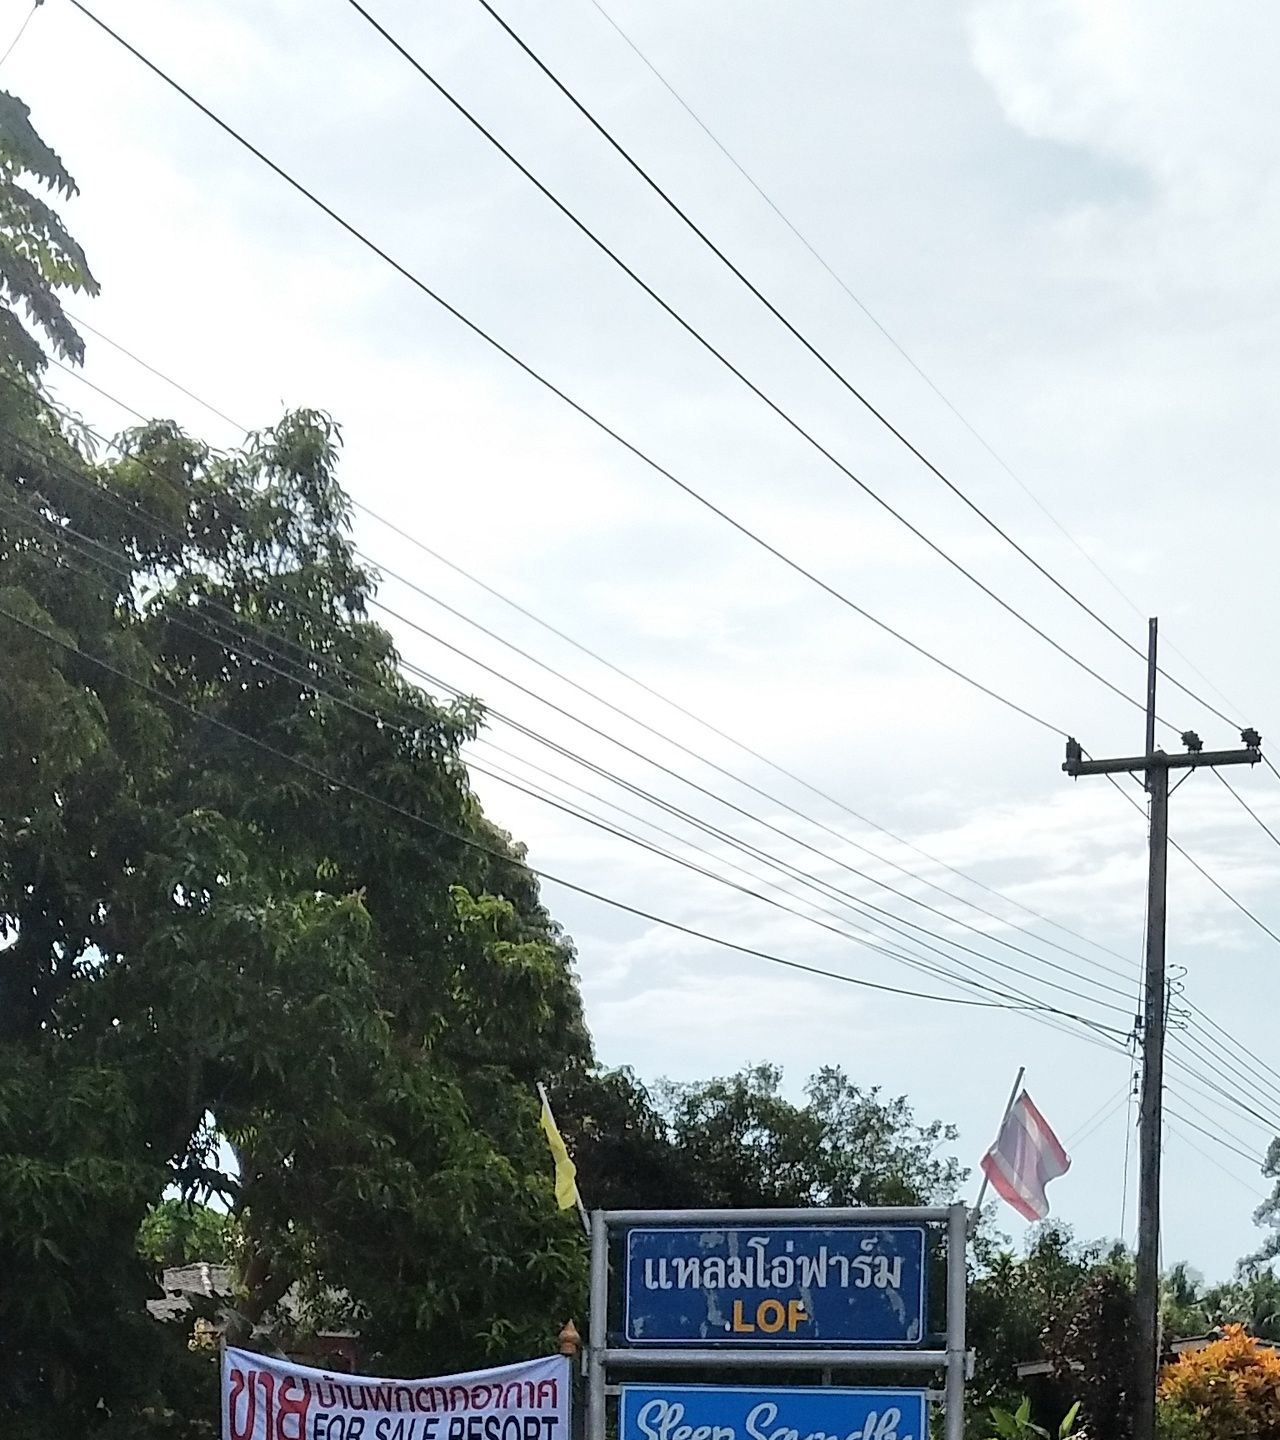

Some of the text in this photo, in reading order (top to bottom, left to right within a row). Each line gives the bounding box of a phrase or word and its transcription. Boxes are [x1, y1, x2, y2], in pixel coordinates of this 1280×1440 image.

[644, 1237, 902, 1290] แหลมโอ่ฟาร์ม
[733, 1299, 809, 1333] LOF
